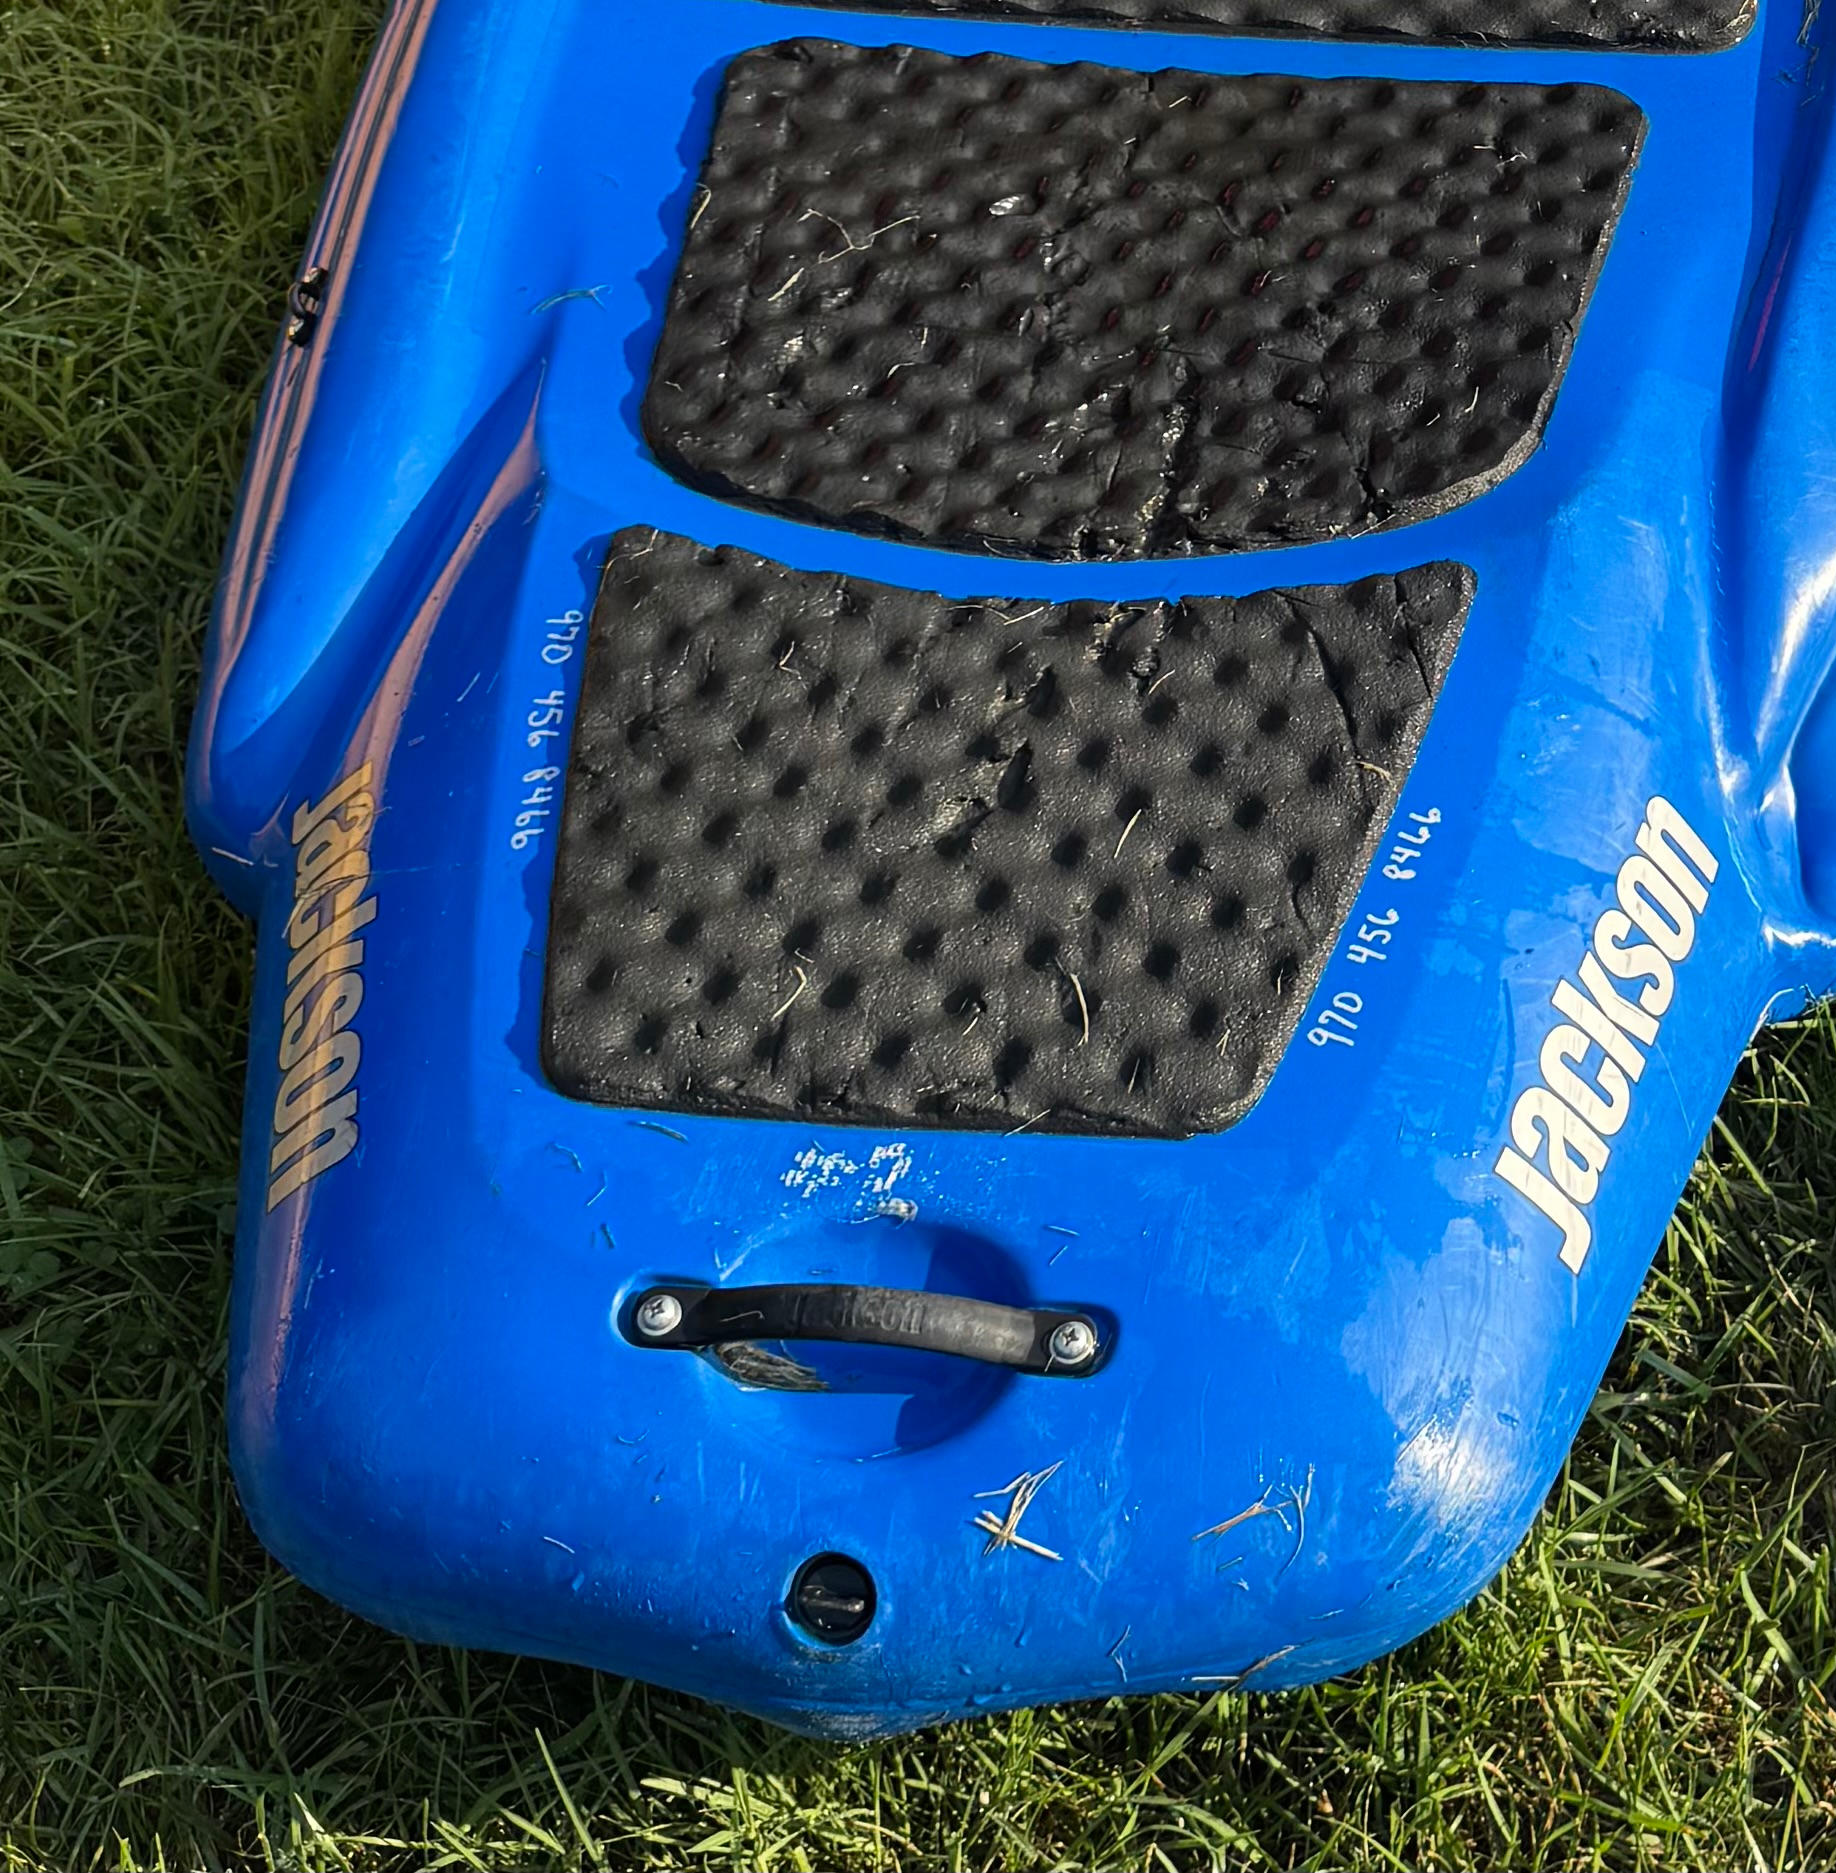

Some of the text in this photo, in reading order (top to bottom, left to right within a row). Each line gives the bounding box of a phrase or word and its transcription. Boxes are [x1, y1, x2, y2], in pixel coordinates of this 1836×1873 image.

[510, 608, 584, 851] 970 456 8466
[266, 760, 378, 1215] Jackson
[1306, 807, 1442, 1048] 970 456 8466
[1494, 795, 1719, 1276] Jackson
